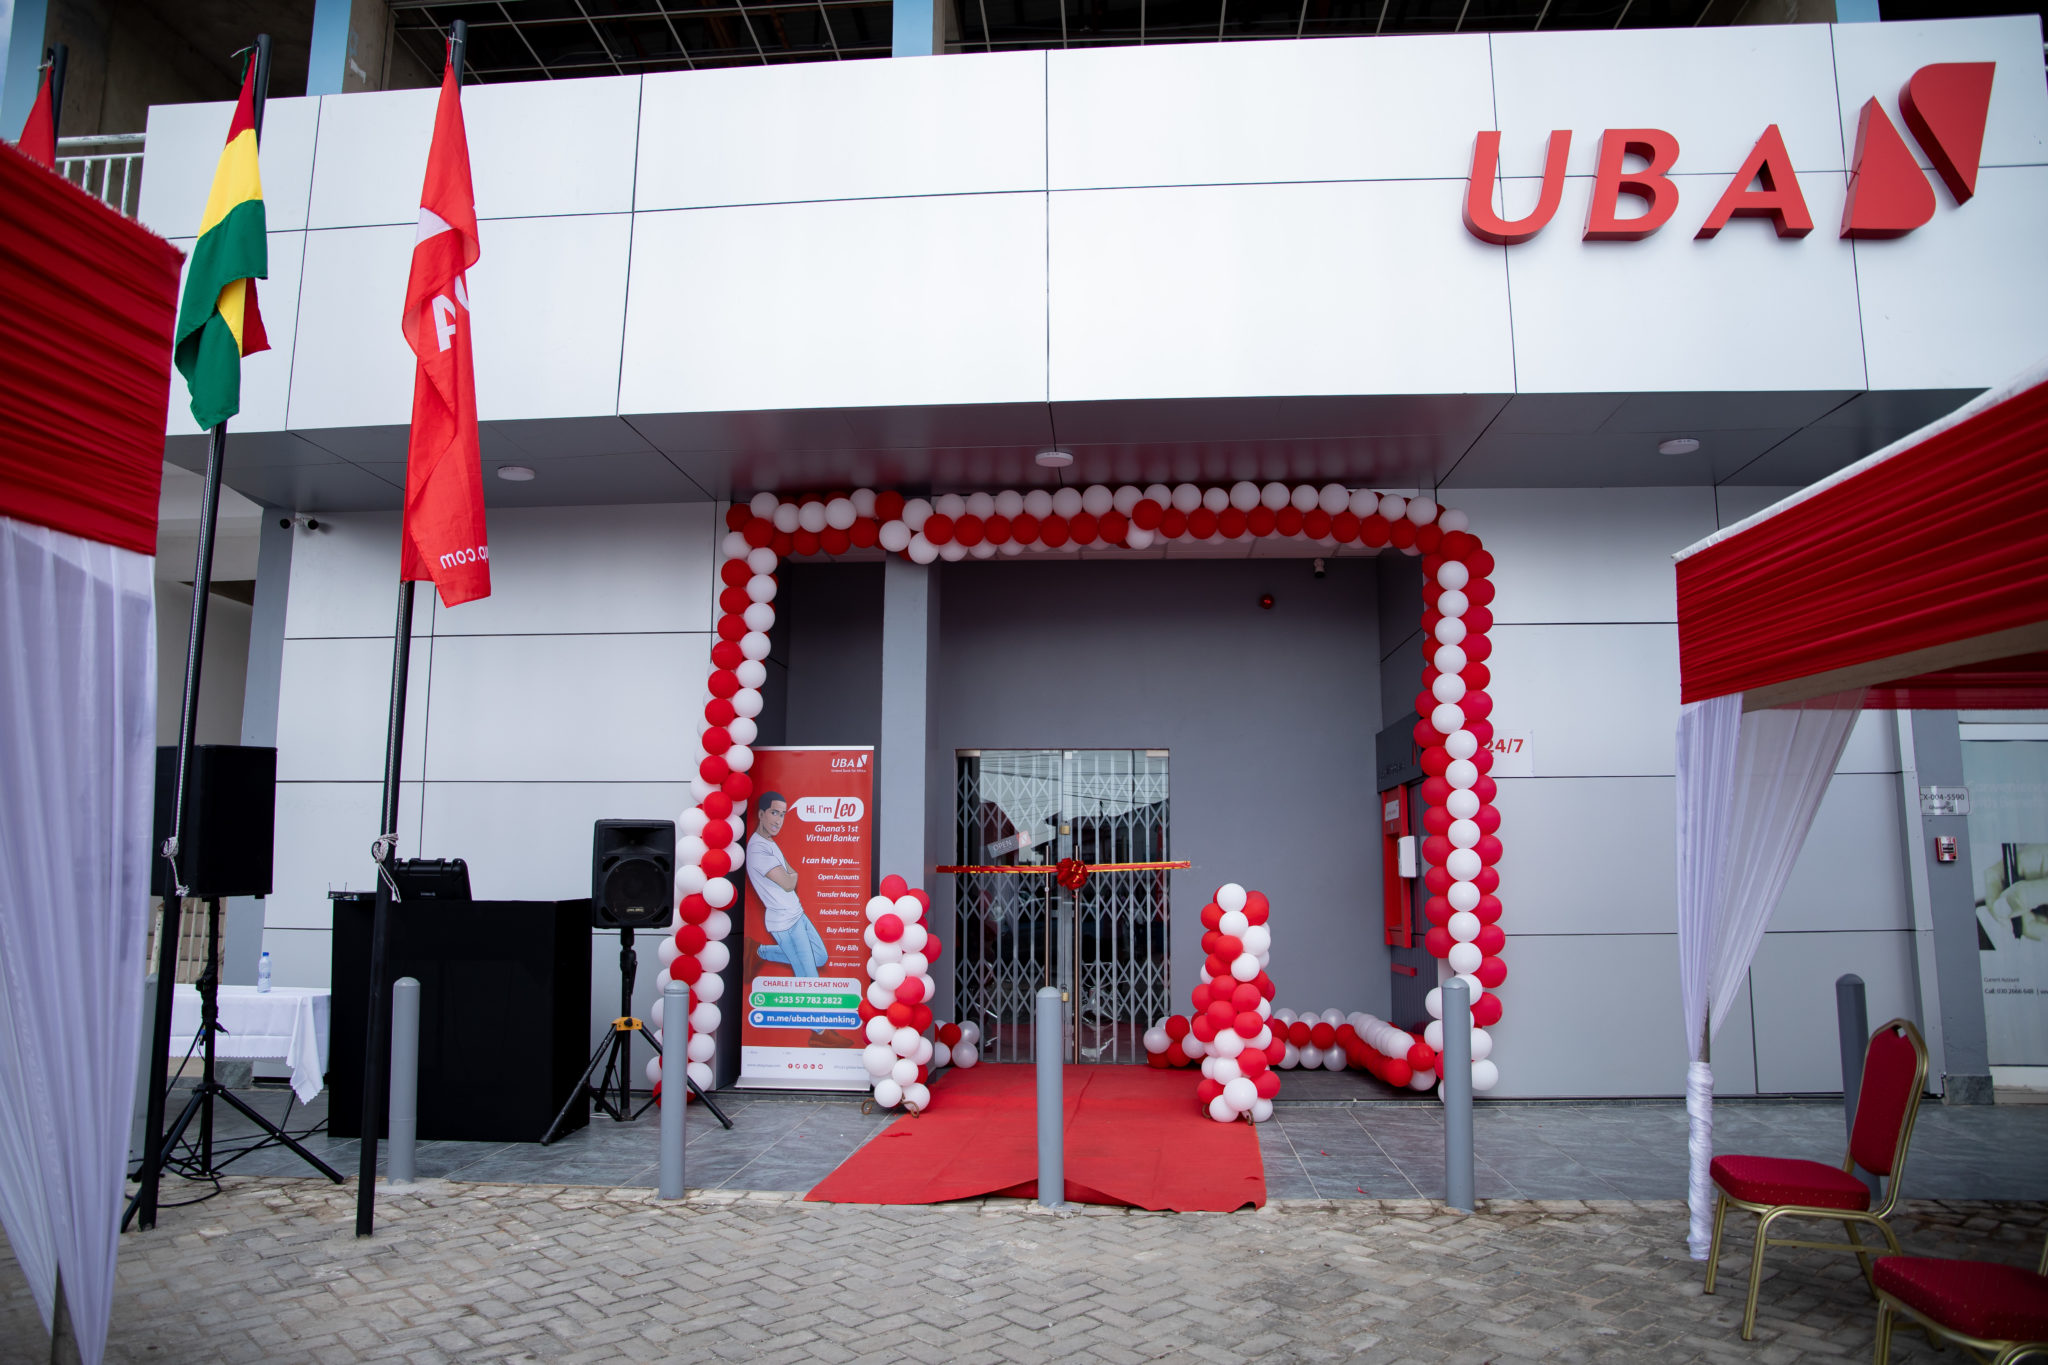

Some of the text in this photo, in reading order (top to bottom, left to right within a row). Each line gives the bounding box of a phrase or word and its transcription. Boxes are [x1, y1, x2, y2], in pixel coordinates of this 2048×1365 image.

[1462, 123, 1815, 246] UBA
[831, 758, 855, 768] UBA
[806, 798, 856, 819] Hi, I'm Leo
[814, 824, 846, 832] Ghana's
[806, 834, 860, 842] Virtual Banker
[992, 839, 1013, 850] OPEN
[802, 856, 806, 864] I
[820, 856, 838, 866] help
[817, 873, 834, 881] Open
[839, 891, 860, 899] Money
[819, 908, 860, 917] Mobile Money
[826, 926, 838, 934] Buy
[835, 944, 848, 952] Pay
[773, 995, 843, 1005] +233 57 782 2822
[766, 1014, 856, 1025] m.me/ubachatbanking
